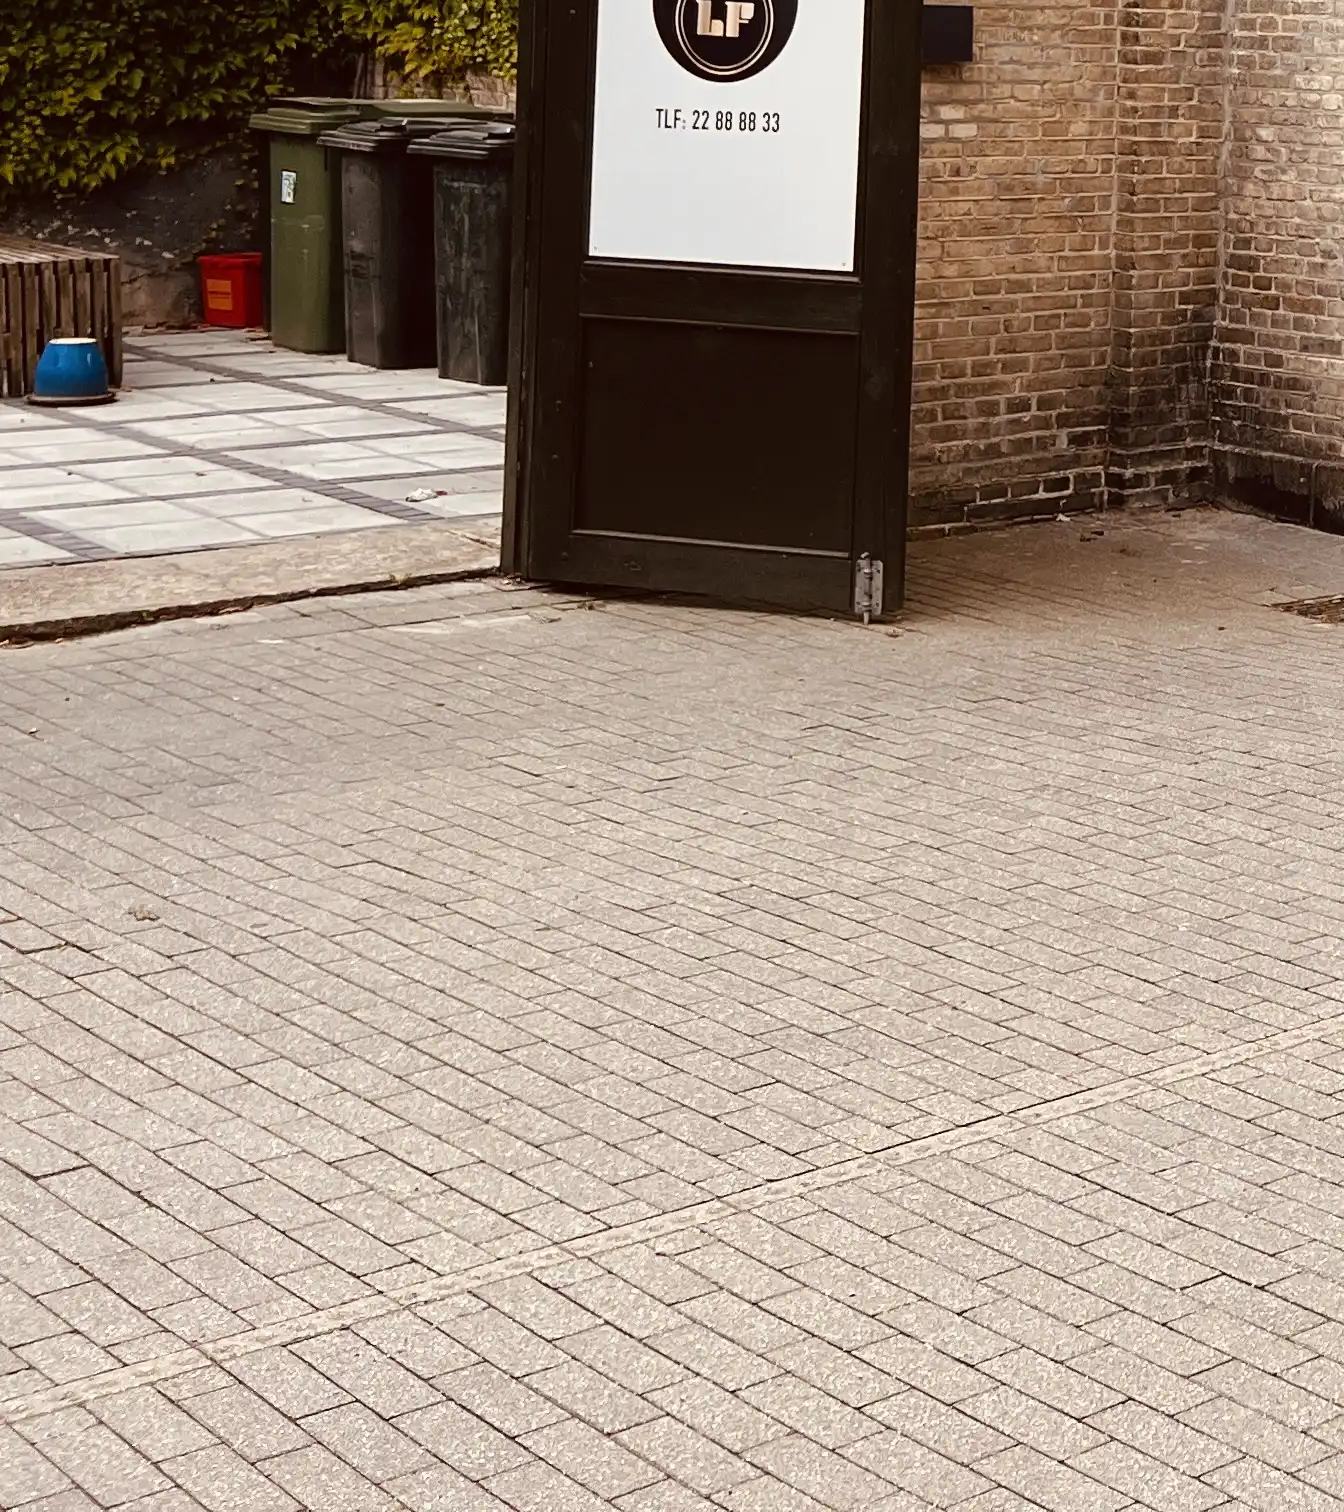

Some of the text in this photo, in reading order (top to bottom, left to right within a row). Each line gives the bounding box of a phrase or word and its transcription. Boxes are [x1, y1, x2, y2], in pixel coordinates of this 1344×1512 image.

[655, 108, 781, 133] TLF: 22 88 88 33
